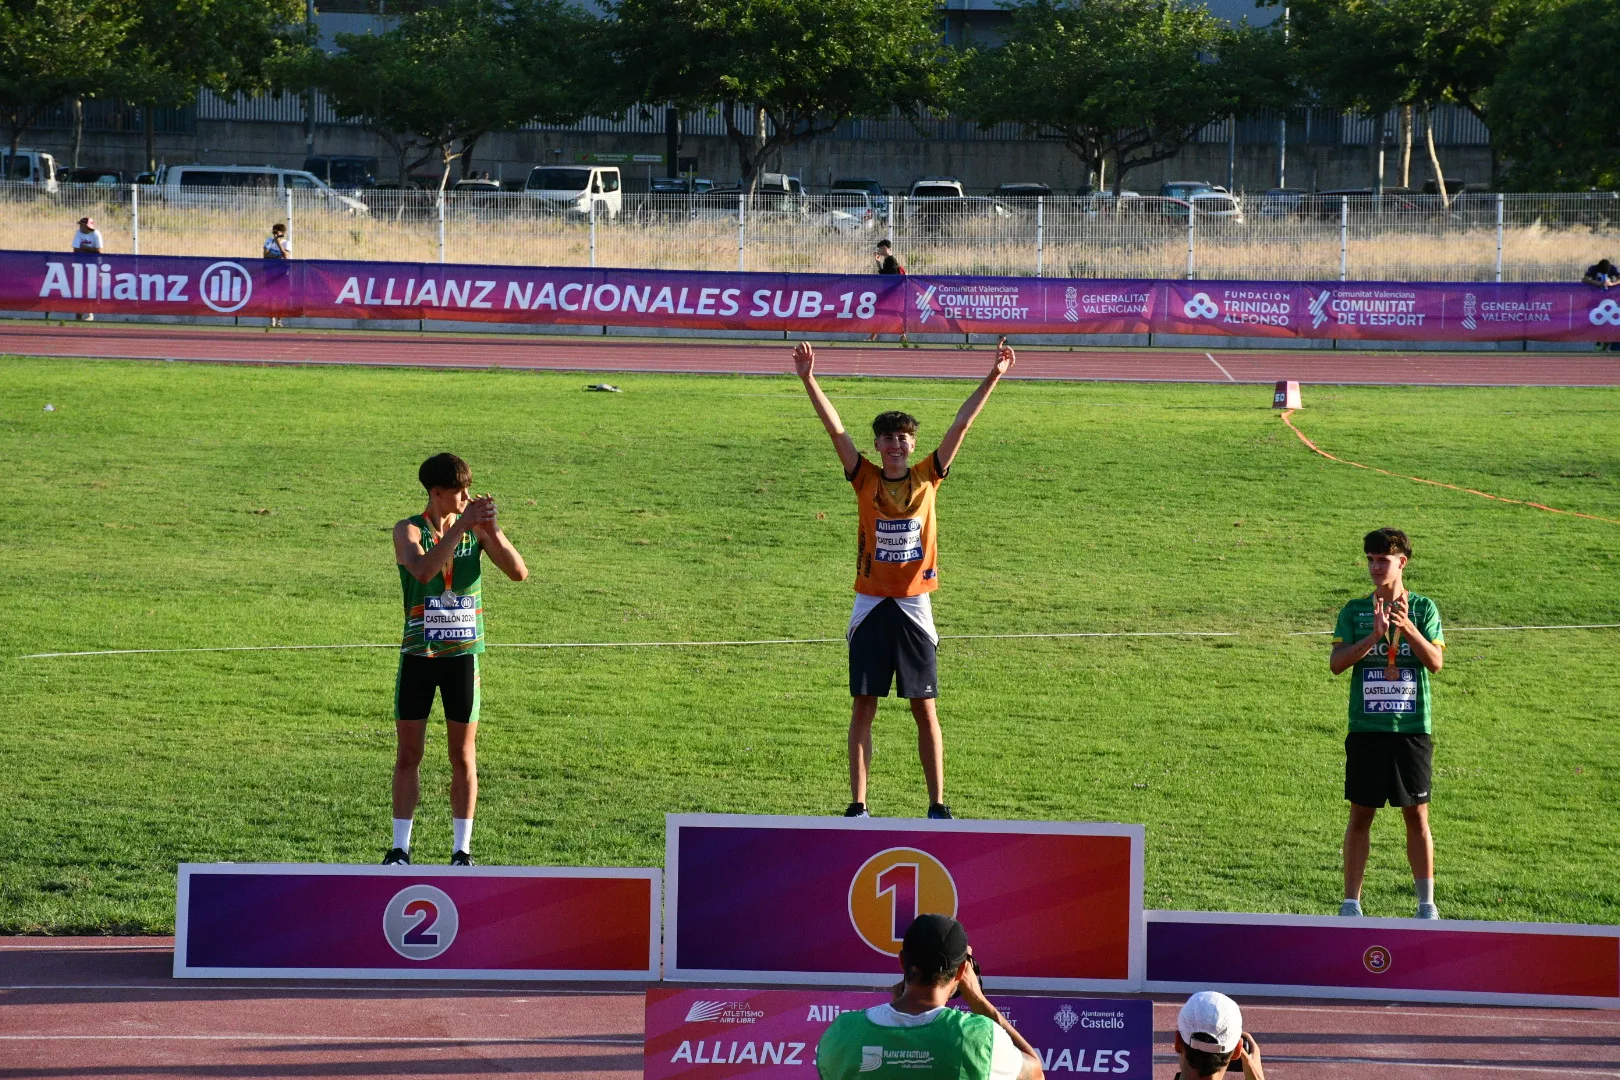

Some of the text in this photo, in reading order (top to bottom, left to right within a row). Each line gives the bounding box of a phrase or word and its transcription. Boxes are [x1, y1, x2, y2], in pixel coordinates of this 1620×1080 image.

[39, 262, 188, 301] Allianz
[939, 285, 1018, 293] Comunitat Valenciana
[1224, 290, 1291, 300] FUNDACIÓN
[1333, 290, 1416, 299] Comunitat Valenciana
[335, 276, 877, 319] ALLIANZ NACIONALES SUB-18
[938, 294, 1019, 307] COMUNITAT
[1082, 293, 1150, 304] GENERALITAT
[1083, 304, 1148, 314] VALENCIANA
[1223, 301, 1290, 314] TRINIDAD
[1332, 299, 1416, 312] COMUNITAT
[1481, 301, 1553, 312] GENERALITAT
[945, 307, 962, 319] DE
[1338, 312, 1356, 325] DE
[1482, 312, 1551, 322] VALENCIANA
[1223, 313, 1290, 326] ALFONSO
[879, 522, 906, 530] Allianz
[426, 614, 460, 623] CASTELLÓN
[1365, 685, 1416, 695] CASTELLÓN 2026
[876, 863, 919, 942] 1
[402, 898, 440, 947] 2
[1370, 951, 1384, 968] 3
[1081, 1010, 1116, 1019] Ajuntament
[1081, 1016, 1125, 1029] Castelló
[670, 1040, 806, 1065] ALLIANZ
